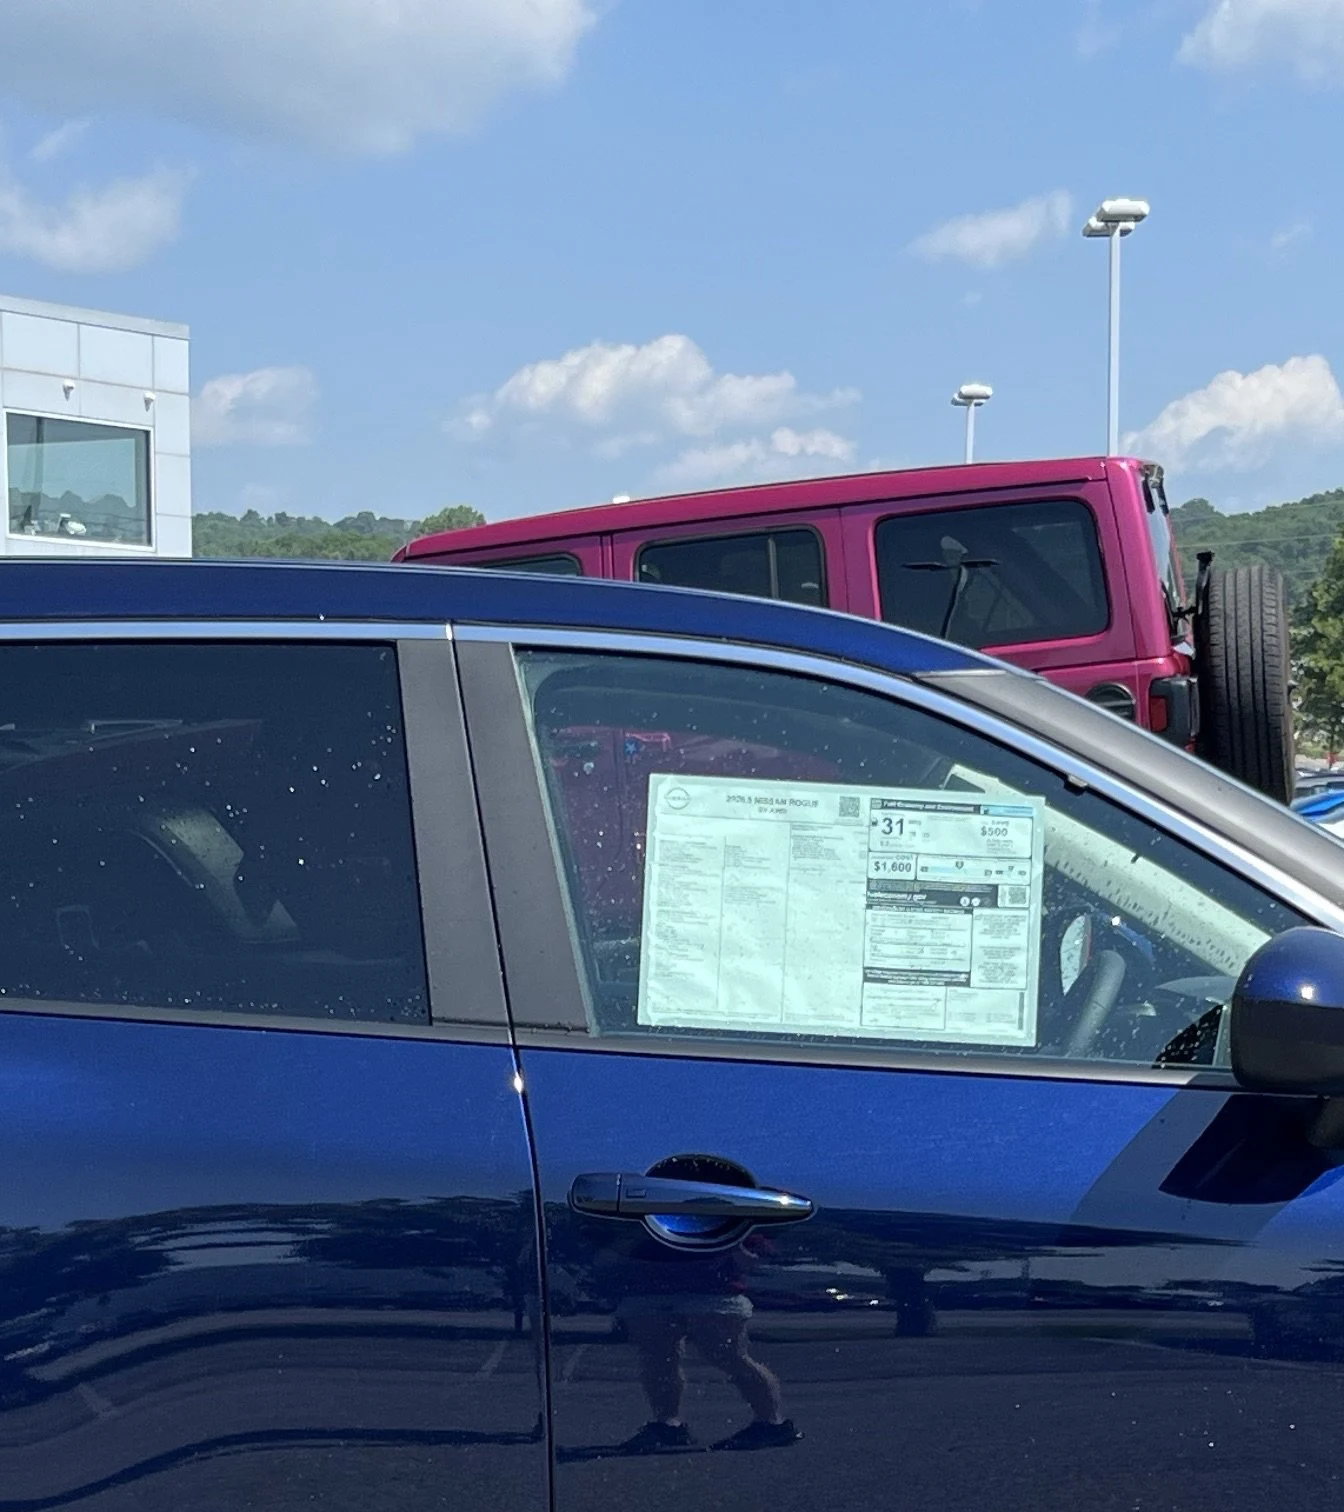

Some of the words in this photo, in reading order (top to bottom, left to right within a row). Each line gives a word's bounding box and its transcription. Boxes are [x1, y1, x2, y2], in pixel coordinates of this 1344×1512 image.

[881, 817, 905, 836] 31
[980, 826, 1009, 837] $500
[873, 861, 912, 873] $1,600
